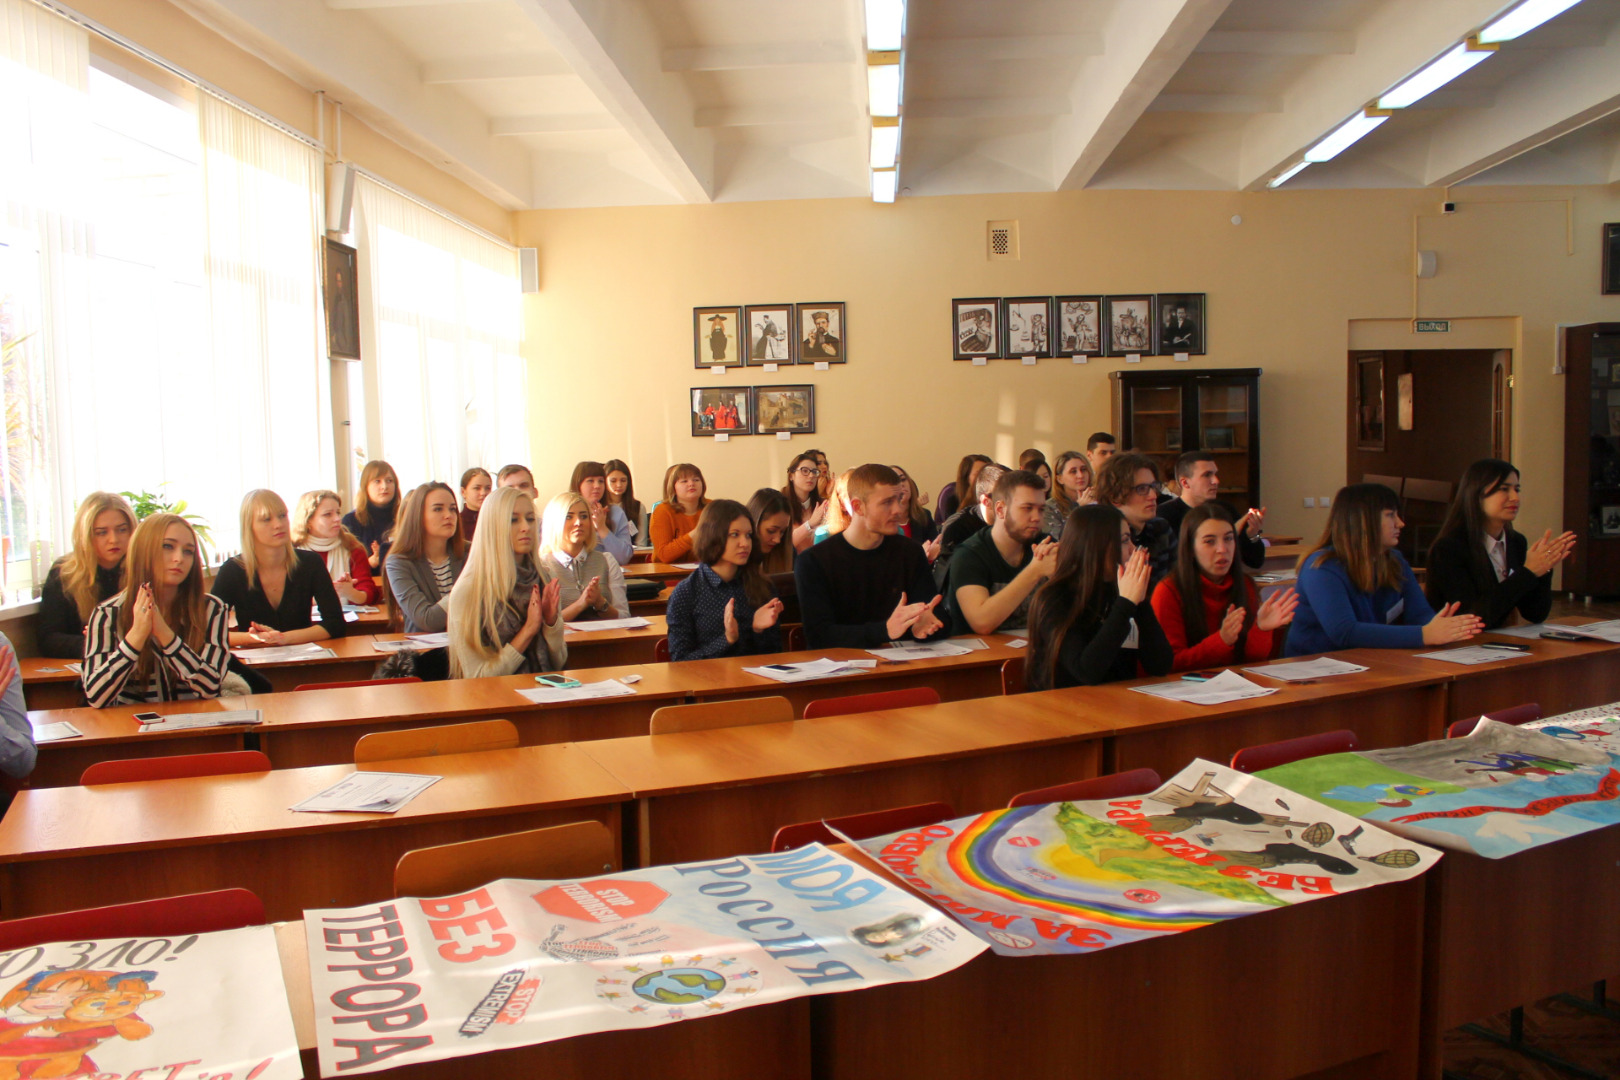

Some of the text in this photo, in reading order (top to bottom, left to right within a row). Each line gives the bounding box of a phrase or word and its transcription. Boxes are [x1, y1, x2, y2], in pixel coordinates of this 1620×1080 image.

[1418, 322, 1447, 331] ВЫХОД
[1106, 800, 1339, 895] БЕЗ ТЕРРОРА
[596, 888, 635, 906] STOP
[748, 845, 888, 912] МОЯ
[558, 883, 623, 921] TERRORISM
[418, 888, 516, 963] БЕЗ
[1031, 918, 1113, 948] ЗА
[47, 935, 199, 970] ЗЛО!
[322, 904, 434, 1071] ТЕРРОРА
[462, 972, 524, 1032] EXTREMISM
[504, 986, 535, 1018] STOP
